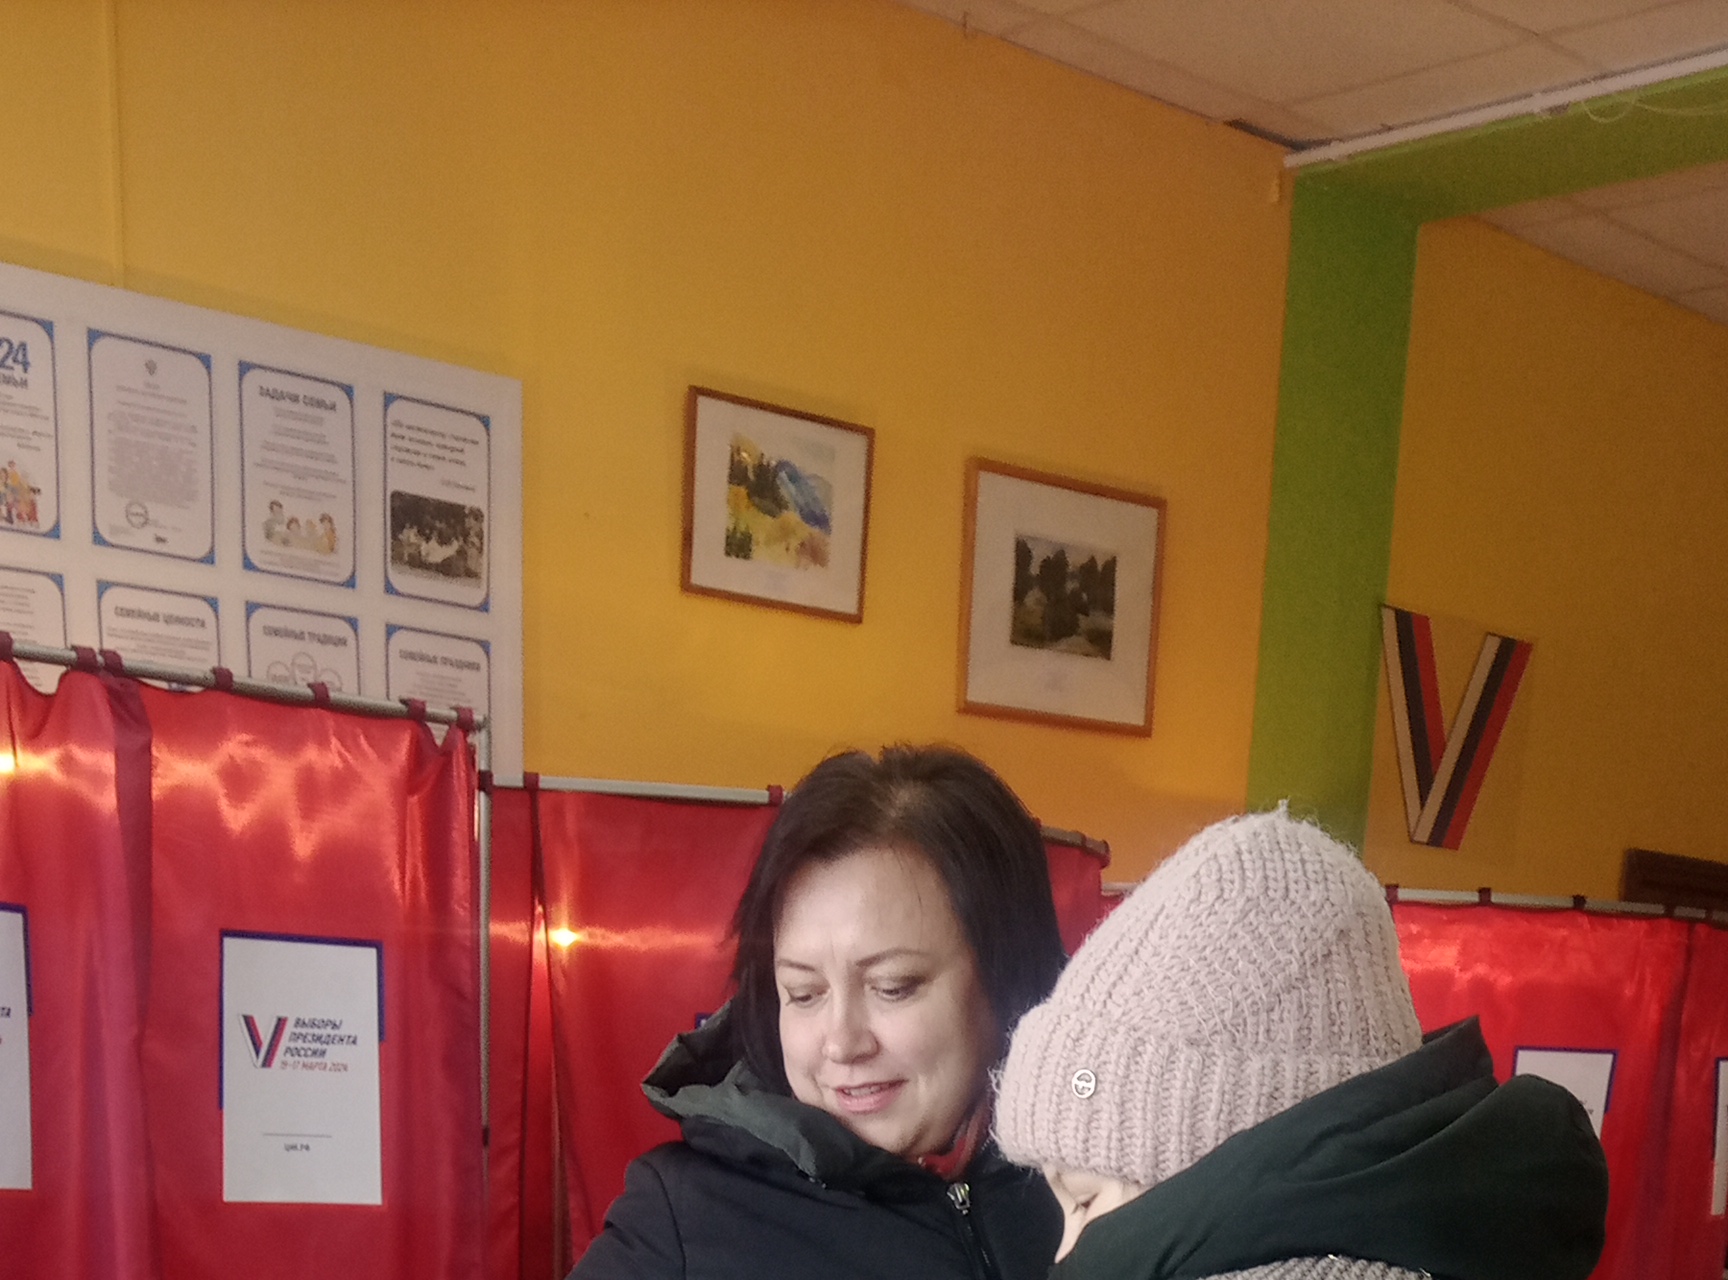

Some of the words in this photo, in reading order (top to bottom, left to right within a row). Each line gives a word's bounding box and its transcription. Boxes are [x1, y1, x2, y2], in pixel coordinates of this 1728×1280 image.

[293, 1017, 343, 1031] ВЫБОРЫ
[288, 1031, 358, 1047] ПРЕЗИДЕНТА
[283, 1046, 327, 1059] РОССИИ
